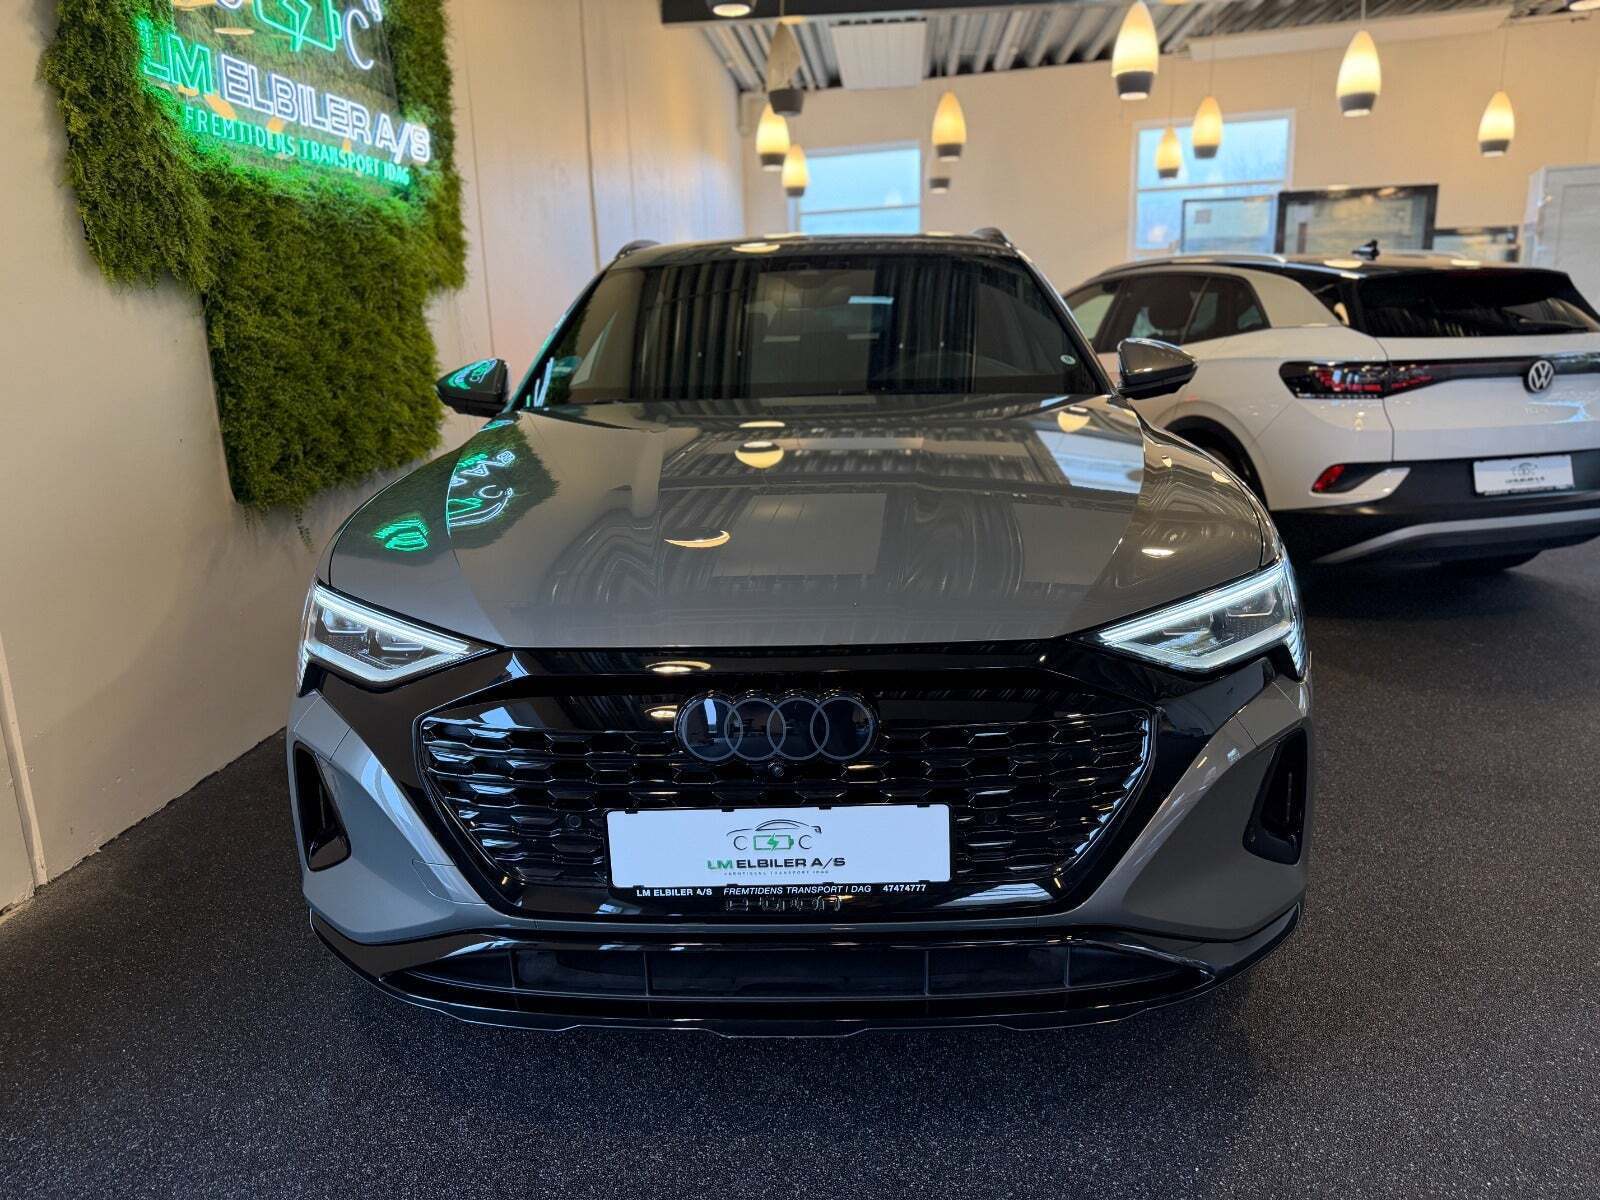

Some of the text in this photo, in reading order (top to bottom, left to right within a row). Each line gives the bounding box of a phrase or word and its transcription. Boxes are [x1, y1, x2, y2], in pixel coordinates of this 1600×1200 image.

[138, 19, 214, 95] LM
[219, 52, 373, 146] ELBILER
[299, 138, 381, 178] TRANSPORT
[706, 856, 847, 870] LM ELBILER A/S
[636, 888, 651, 897] LM
[653, 887, 694, 897] ELBILER
[696, 887, 713, 896] A/S
[723, 886, 784, 897] FREMTIDENS
[786, 885, 843, 895] TRANSPORT
[850, 884, 872, 894] DAG
[882, 883, 927, 893] 47474777
